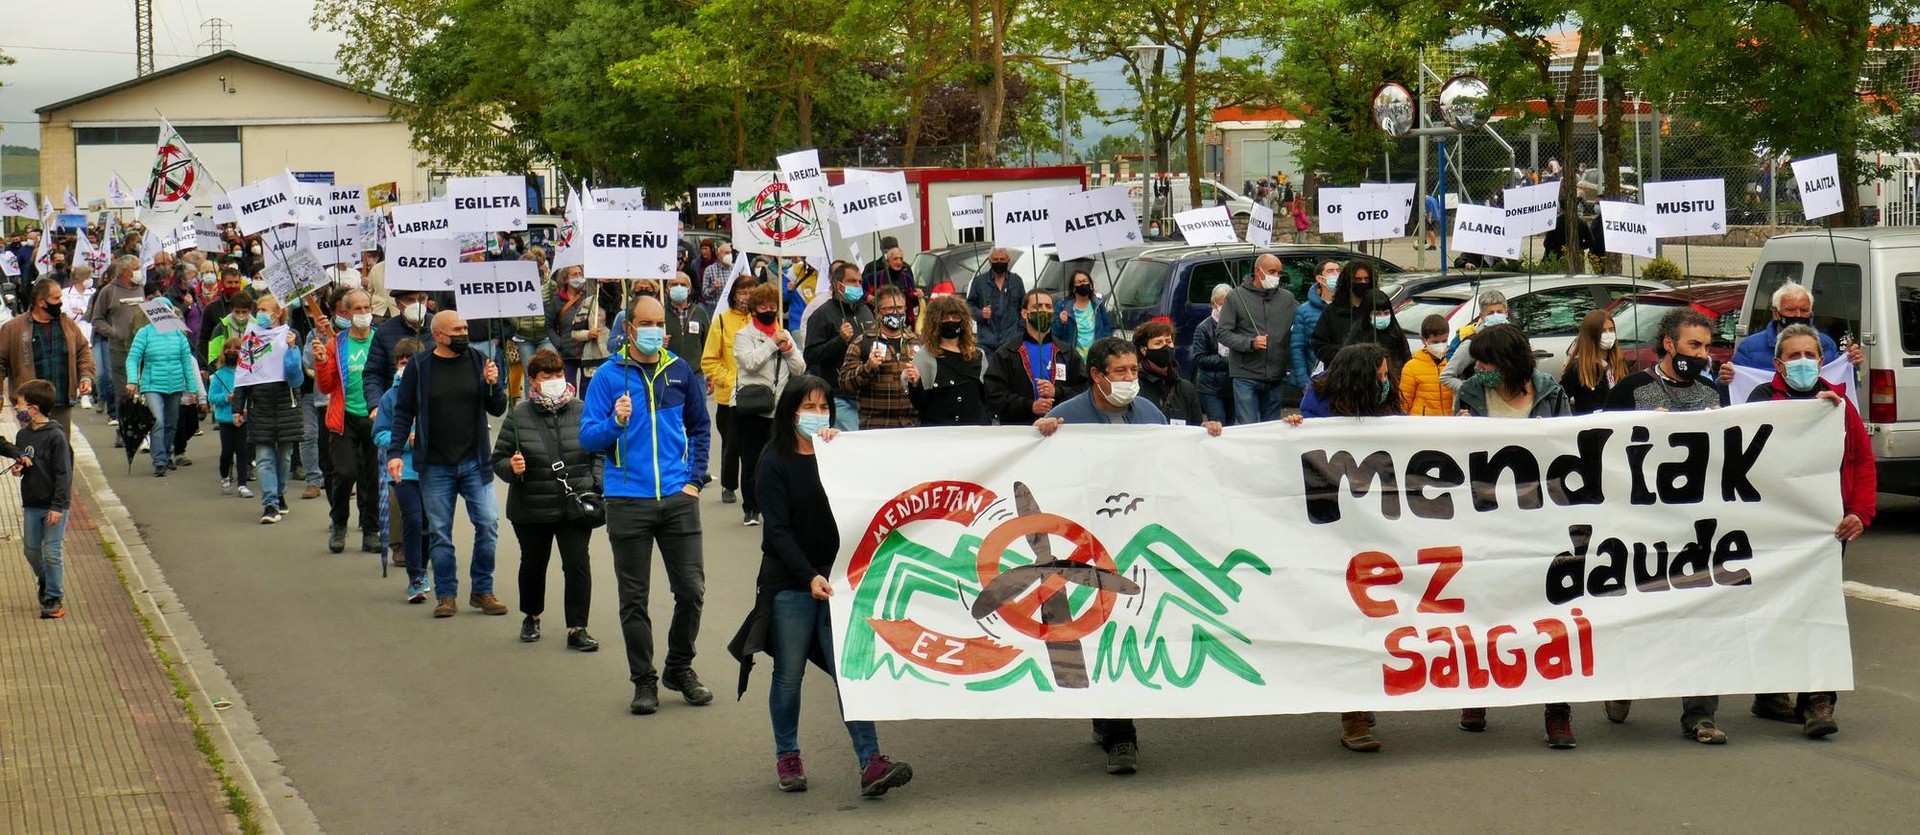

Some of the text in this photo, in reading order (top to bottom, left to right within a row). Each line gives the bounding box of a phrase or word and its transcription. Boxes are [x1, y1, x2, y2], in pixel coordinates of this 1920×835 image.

[789, 167, 820, 182] AREATZA
[1805, 175, 1836, 194] ALAITZA
[241, 193, 287, 215] MEZKIA
[455, 196, 521, 210] EGILETA
[842, 191, 903, 214] JAUREGI
[1505, 201, 1557, 217] DONEMILIAGA
[1656, 200, 1715, 214] MUSITU
[952, 208, 984, 217] KUARTANGO
[1065, 208, 1126, 233] ALETXA
[1357, 209, 1389, 221] OTEO
[398, 218, 448, 235] LABRAZA
[1181, 219, 1231, 232] TROKONIZ
[317, 238, 353, 250] EGILAZ
[593, 231, 668, 248] GEREÑU
[398, 256, 447, 268] GAZEO
[460, 280, 536, 295] HEREDIA
[872, 484, 984, 544] MENDIETAN
[1546, 518, 1753, 605] daude
[910, 631, 965, 667] EZ
